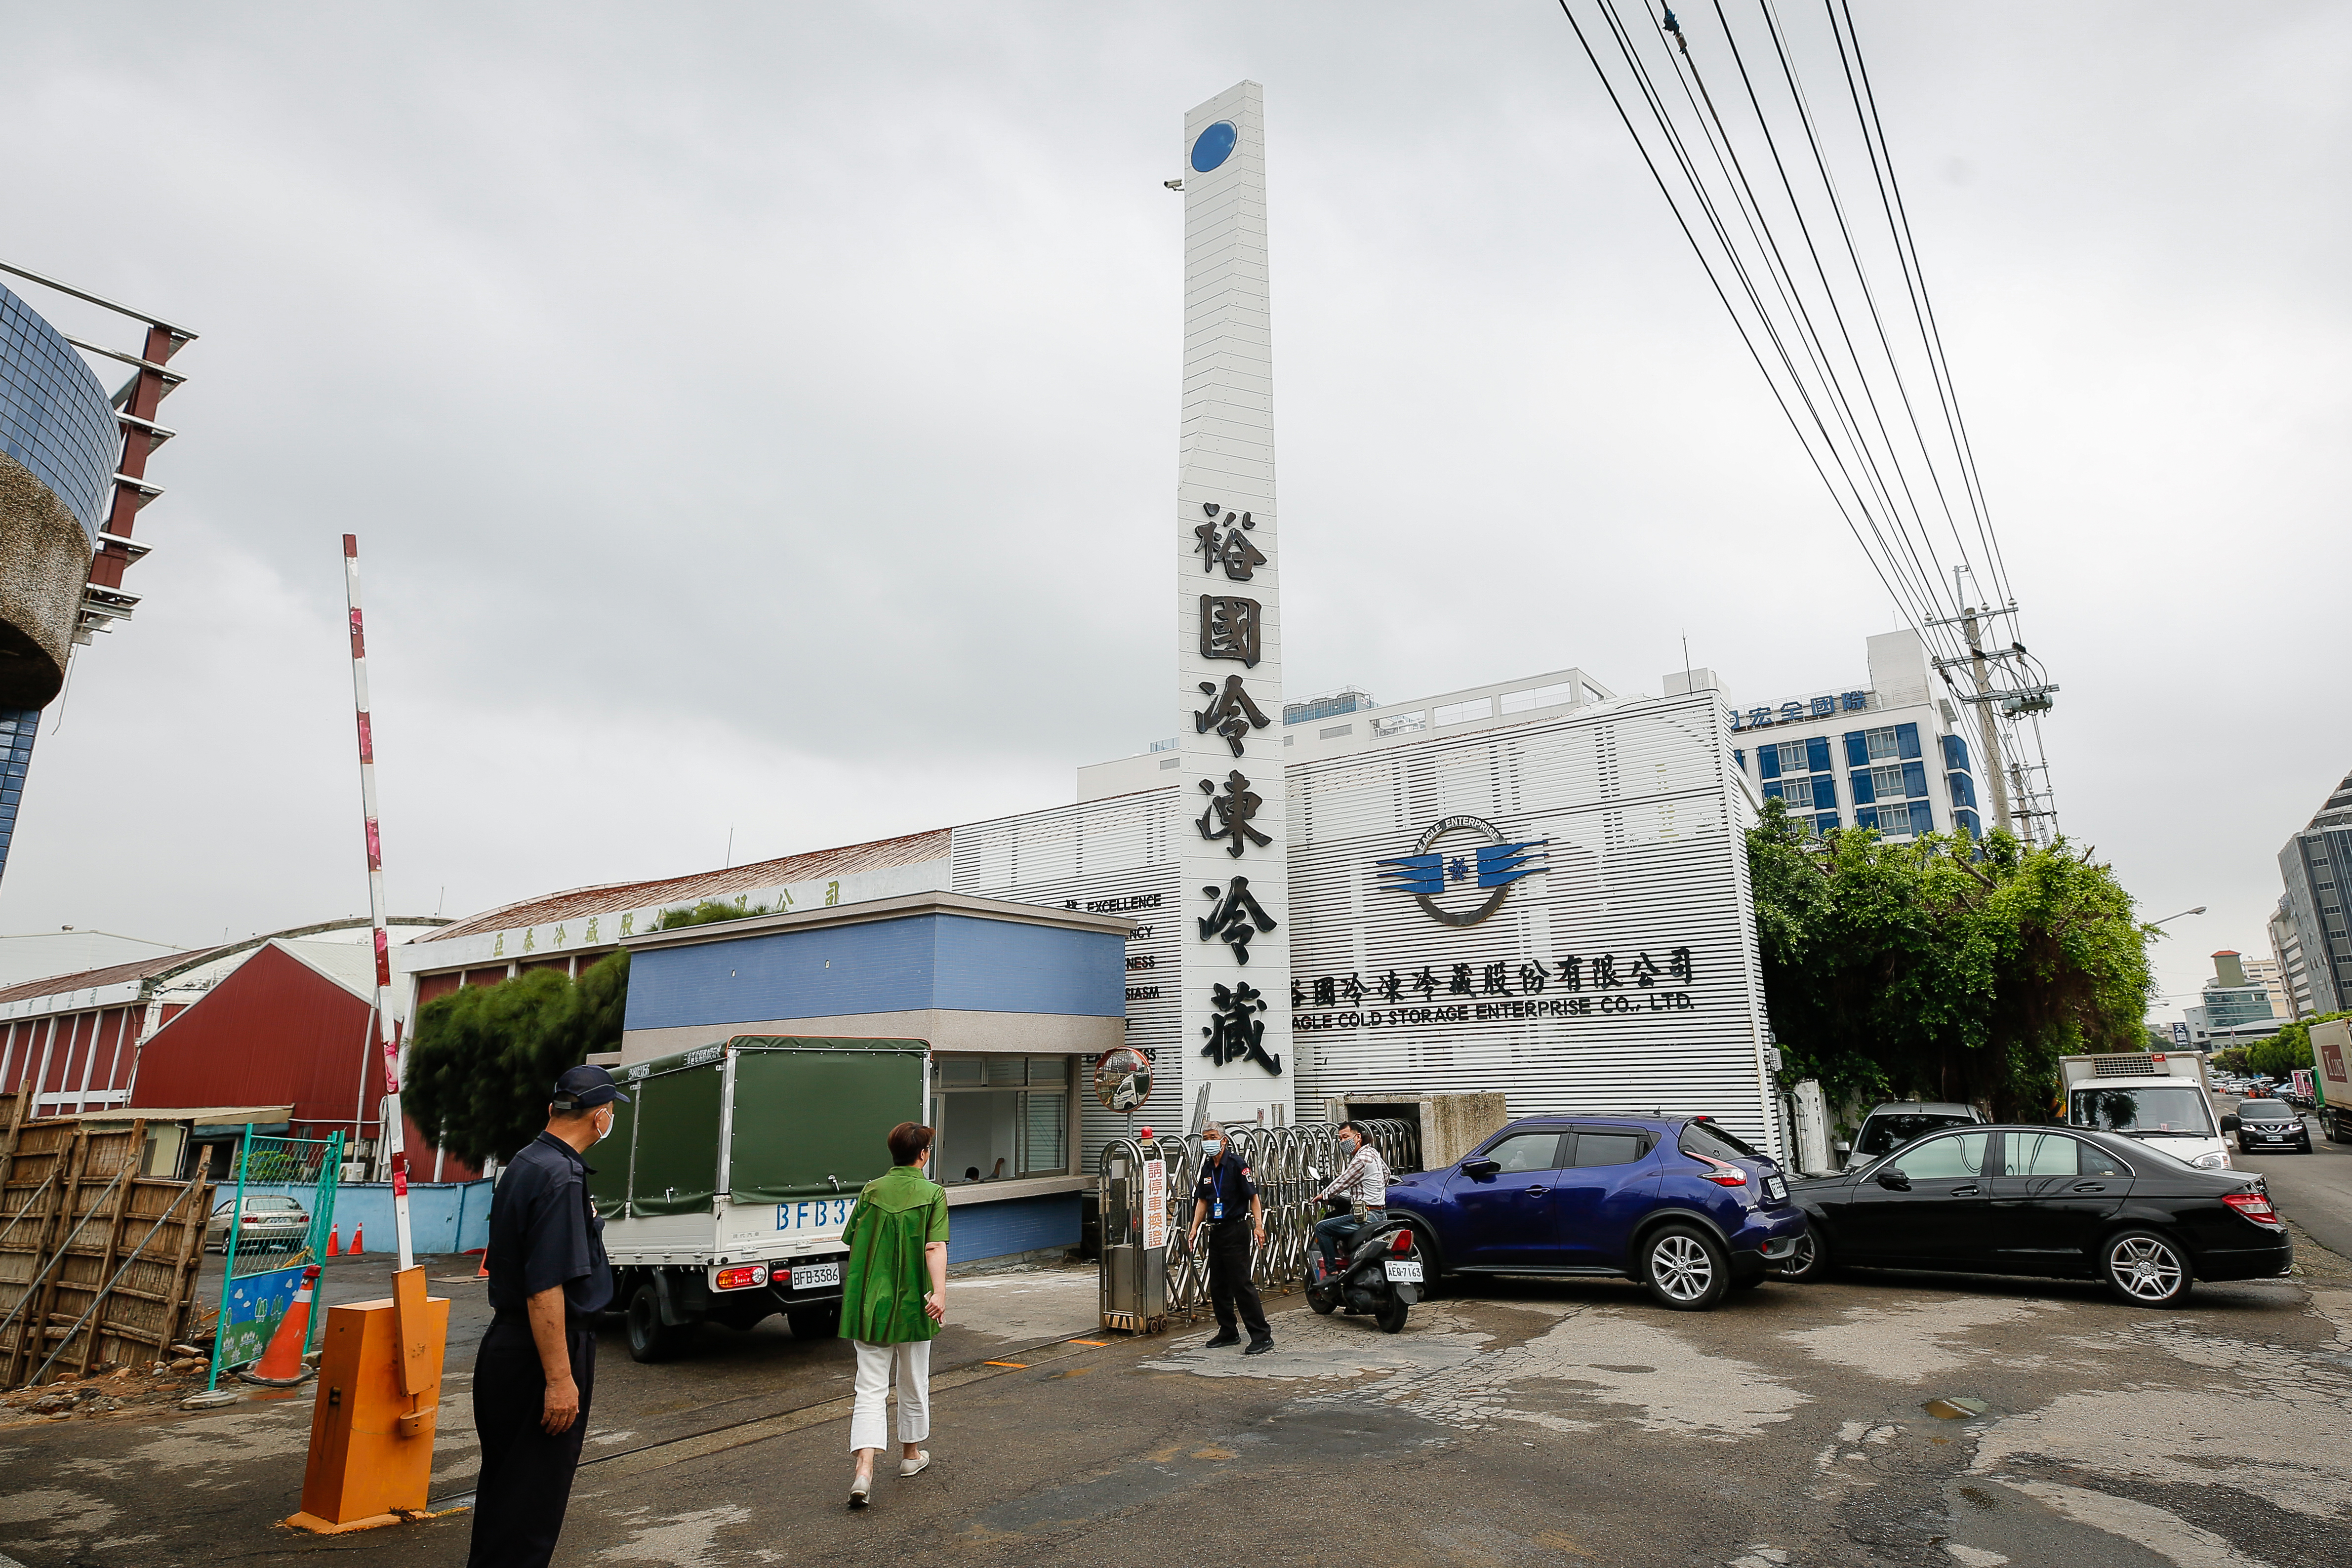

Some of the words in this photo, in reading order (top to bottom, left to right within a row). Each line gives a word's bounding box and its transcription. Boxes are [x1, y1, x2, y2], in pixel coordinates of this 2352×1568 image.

[1748, 690, 1867, 726] 宏全國際
[1193, 502, 1283, 1077] 裕國冷凍冷藏
[1417, 823, 1443, 851] EAGLE
[1444, 815, 1500, 841] ENTERPRISE
[1087, 893, 1161, 913] EXCELLENCE
[1125, 925, 1153, 940] NCY
[1338, 1011, 1382, 1028] COLD
[1388, 1005, 1468, 1024] STORAGE
[1476, 998, 1591, 1020] ENTERPRISE
[1650, 993, 1695, 1010] LTD.
[776, 1198, 858, 1231] BFB3
[1147, 1162, 1163, 1247] 請停車換證
[793, 1267, 838, 1286] BFB-3386
[1388, 1267, 1421, 1278] AEQ-7163
